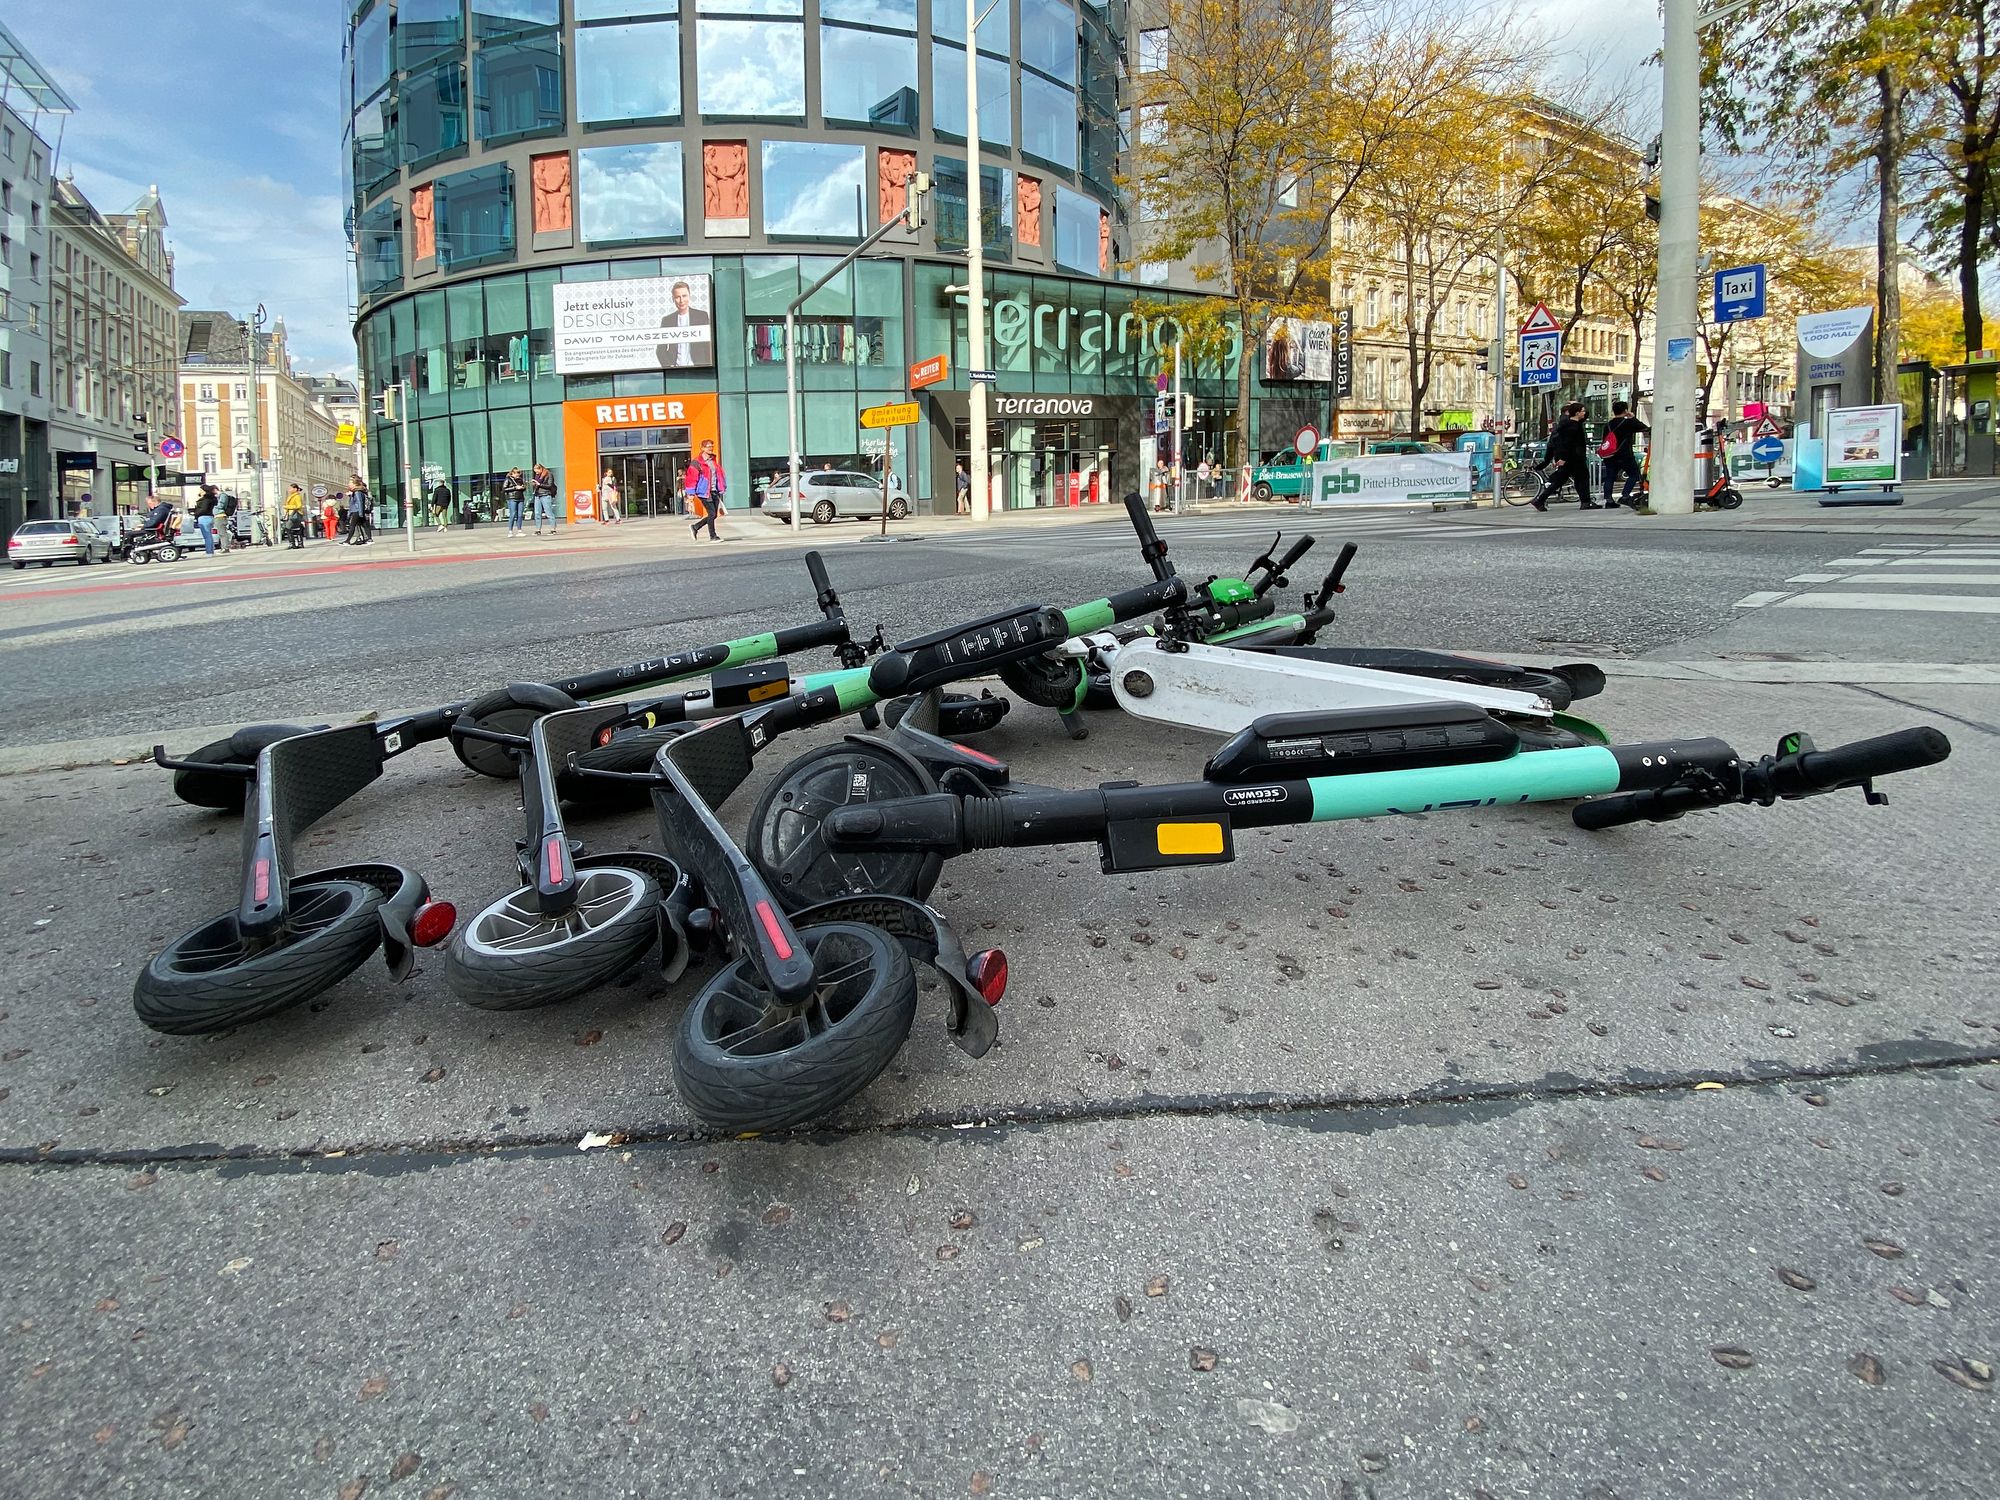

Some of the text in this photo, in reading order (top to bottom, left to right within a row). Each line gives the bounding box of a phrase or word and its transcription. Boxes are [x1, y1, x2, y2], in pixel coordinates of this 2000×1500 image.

[1724, 278, 1753, 296] Taxi
[563, 298, 634, 312] Jetzt exklusiv
[563, 311, 636, 329] DESIGNS
[564, 330, 702, 345] DAWID TOMASZEWSKI
[1308, 327, 1330, 340] ciao!
[1804, 330, 1856, 342] 1.000 MAL:
[1308, 340, 1329, 351] WIEN
[1542, 357, 1554, 367] 20
[1810, 361, 1841, 372] DRINK
[920, 361, 940, 376] REITER
[1808, 370, 1845, 379] WATER!
[1527, 372, 1552, 381] Zone
[595, 401, 685, 424] REITER
[871, 406, 912, 417] Umleitung
[1363, 475, 1460, 489] Pittel+Brausewetter
[1231, 789, 1280, 801] SEGWAY
